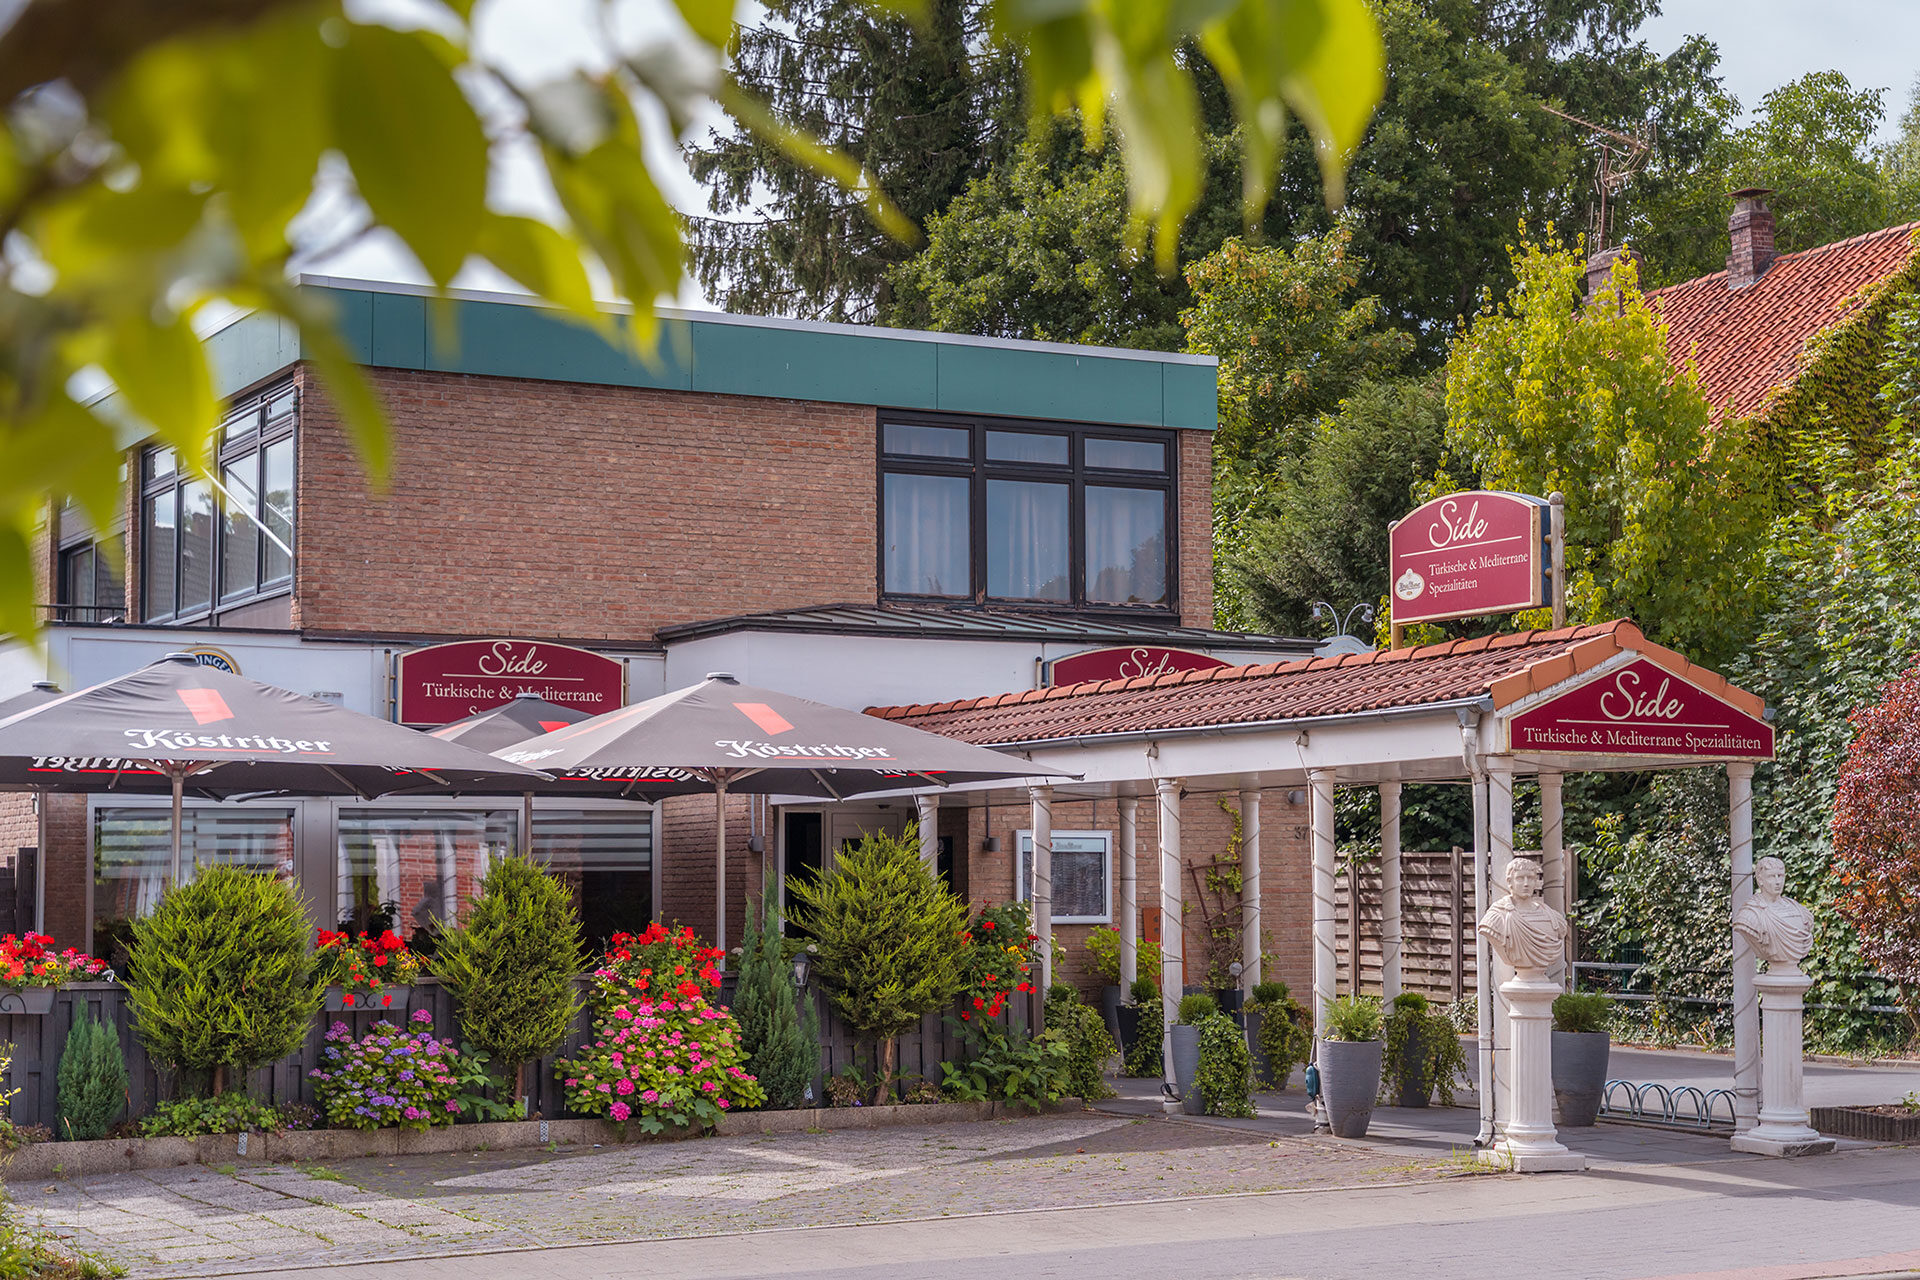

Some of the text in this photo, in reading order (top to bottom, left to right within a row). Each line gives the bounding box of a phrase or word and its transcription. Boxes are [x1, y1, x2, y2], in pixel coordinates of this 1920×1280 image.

[1429, 500, 1489, 548] Side
[1429, 552, 1528, 576] Türkische & Mediterrane
[1429, 578, 1478, 598] Spezialitäten
[478, 641, 548, 675] Side
[422, 682, 603, 703] Türkische & Mditerrane
[1600, 670, 1685, 720] Side
[124, 728, 331, 753] Köstritzer
[714, 739, 890, 760] Köstritzer
[1523, 727, 1762, 752] Türkische & Mediterrane Spezialitäten
